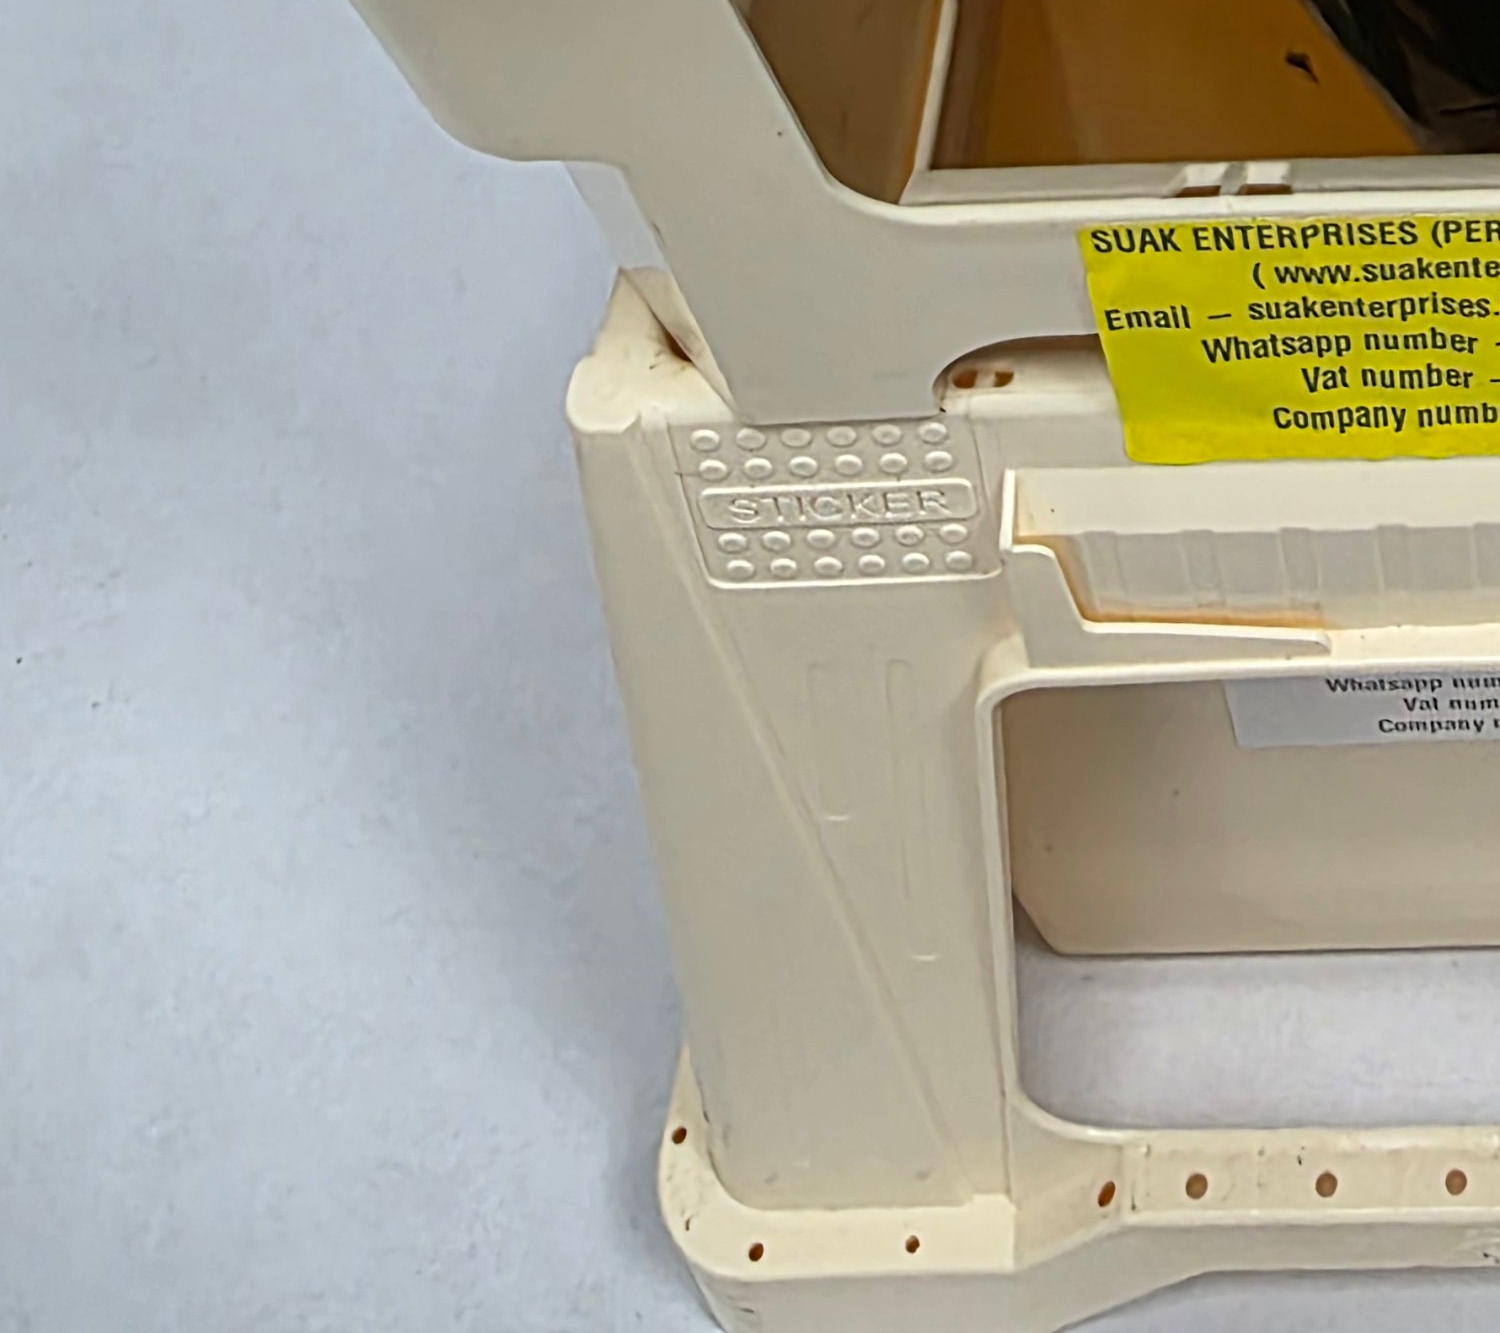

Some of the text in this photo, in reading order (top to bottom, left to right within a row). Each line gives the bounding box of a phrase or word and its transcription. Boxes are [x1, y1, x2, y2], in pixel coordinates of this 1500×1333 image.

[1091, 227, 1182, 254] SUAK
[1194, 220, 1419, 251] ENTERPRISES
[1104, 304, 1191, 332] Email
[1201, 333, 1352, 364] Whatsapp
[1364, 327, 1479, 354] number
[1302, 365, 1350, 393] Vat
[1361, 363, 1473, 389] number
[1273, 406, 1406, 433] Company
[727, 489, 952, 524] STICKER
[1325, 677, 1443, 692] Whatsapp
[1402, 696, 1438, 712] Vat
[1378, 718, 1485, 733] Company
